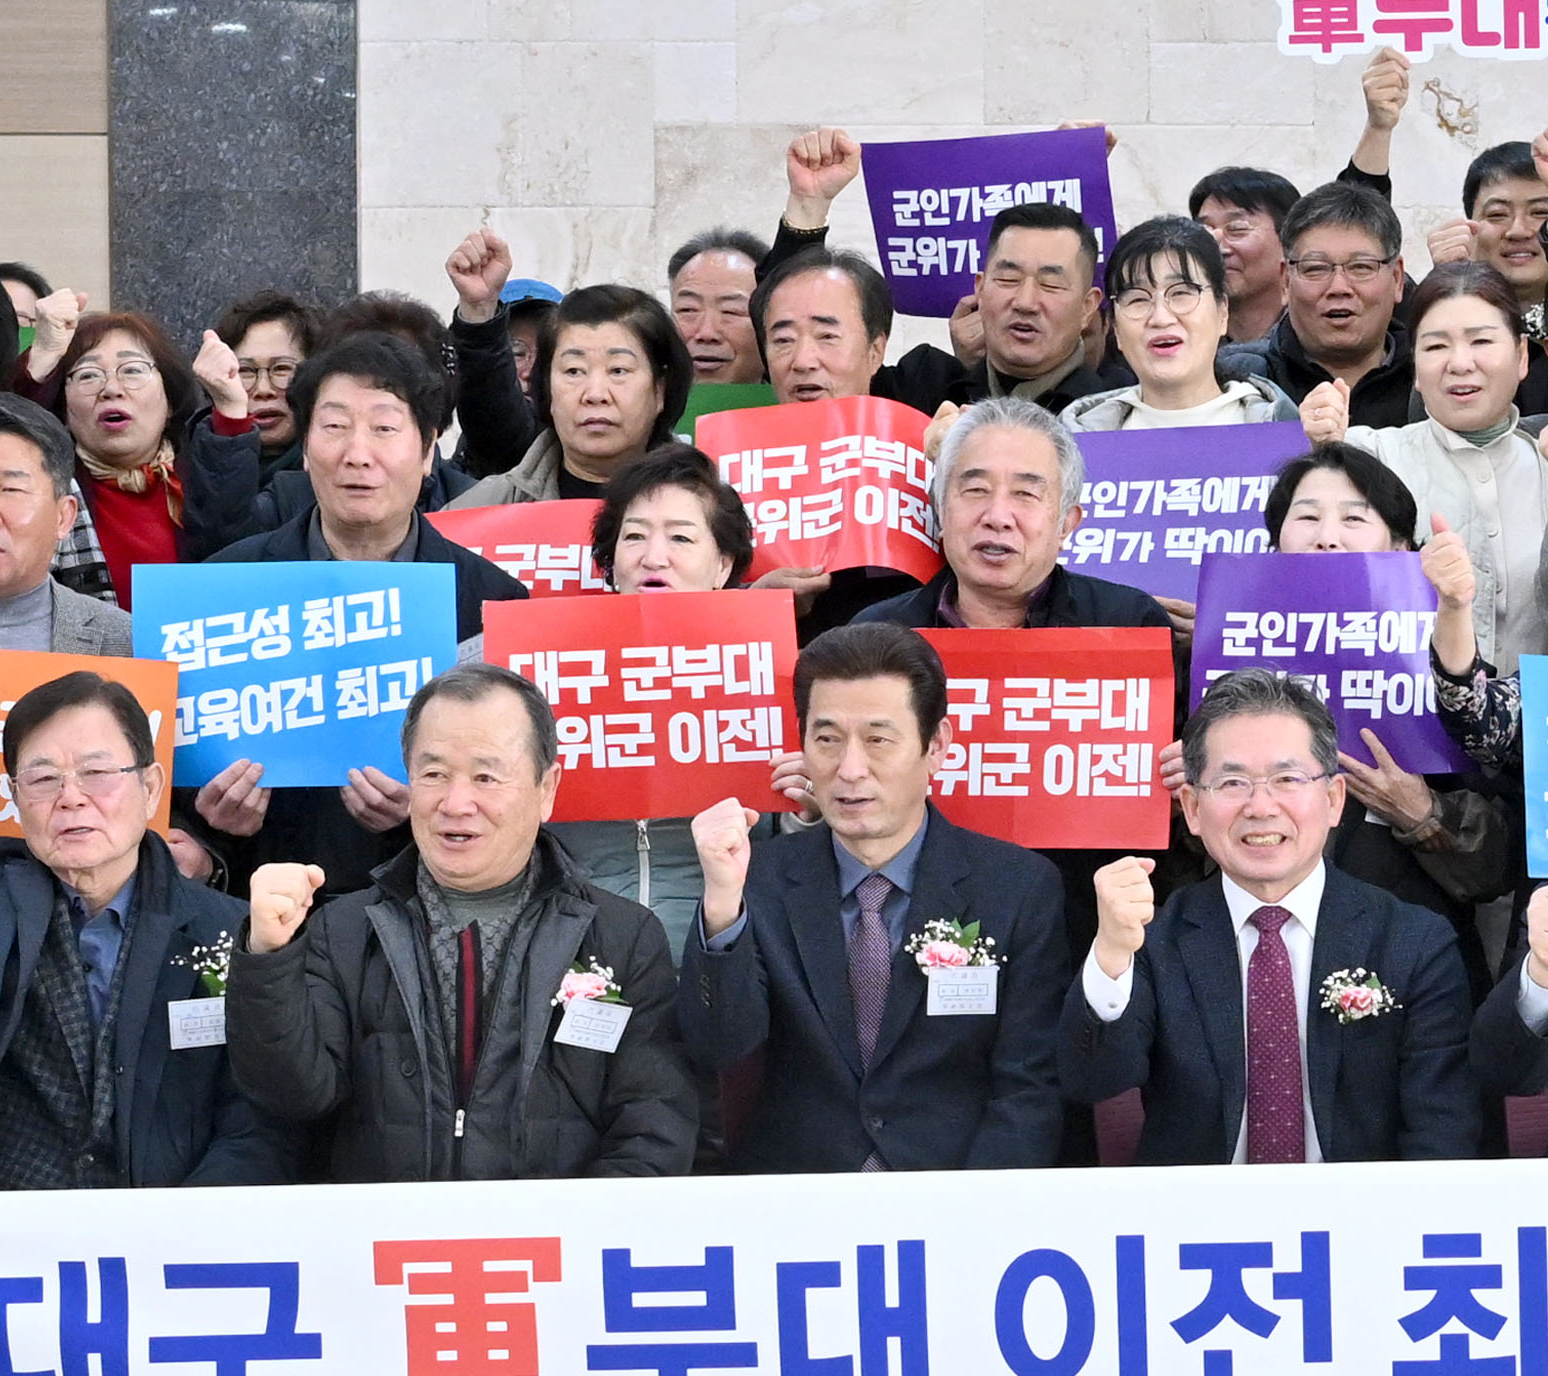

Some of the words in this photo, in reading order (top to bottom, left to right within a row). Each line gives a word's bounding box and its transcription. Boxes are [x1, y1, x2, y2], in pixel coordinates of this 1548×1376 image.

[887, 236, 981, 277] 군위가
[718, 444, 809, 495] 대구
[161, 604, 292, 673] 접근성
[302, 587, 402, 651] 최고!
[620, 641, 776, 702] 군부대
[1002, 677, 1150, 732] 군부대
[555, 712, 656, 770] 위군
[926, 742, 1031, 797] 위군
[1043, 742, 1154, 797] 이전!
